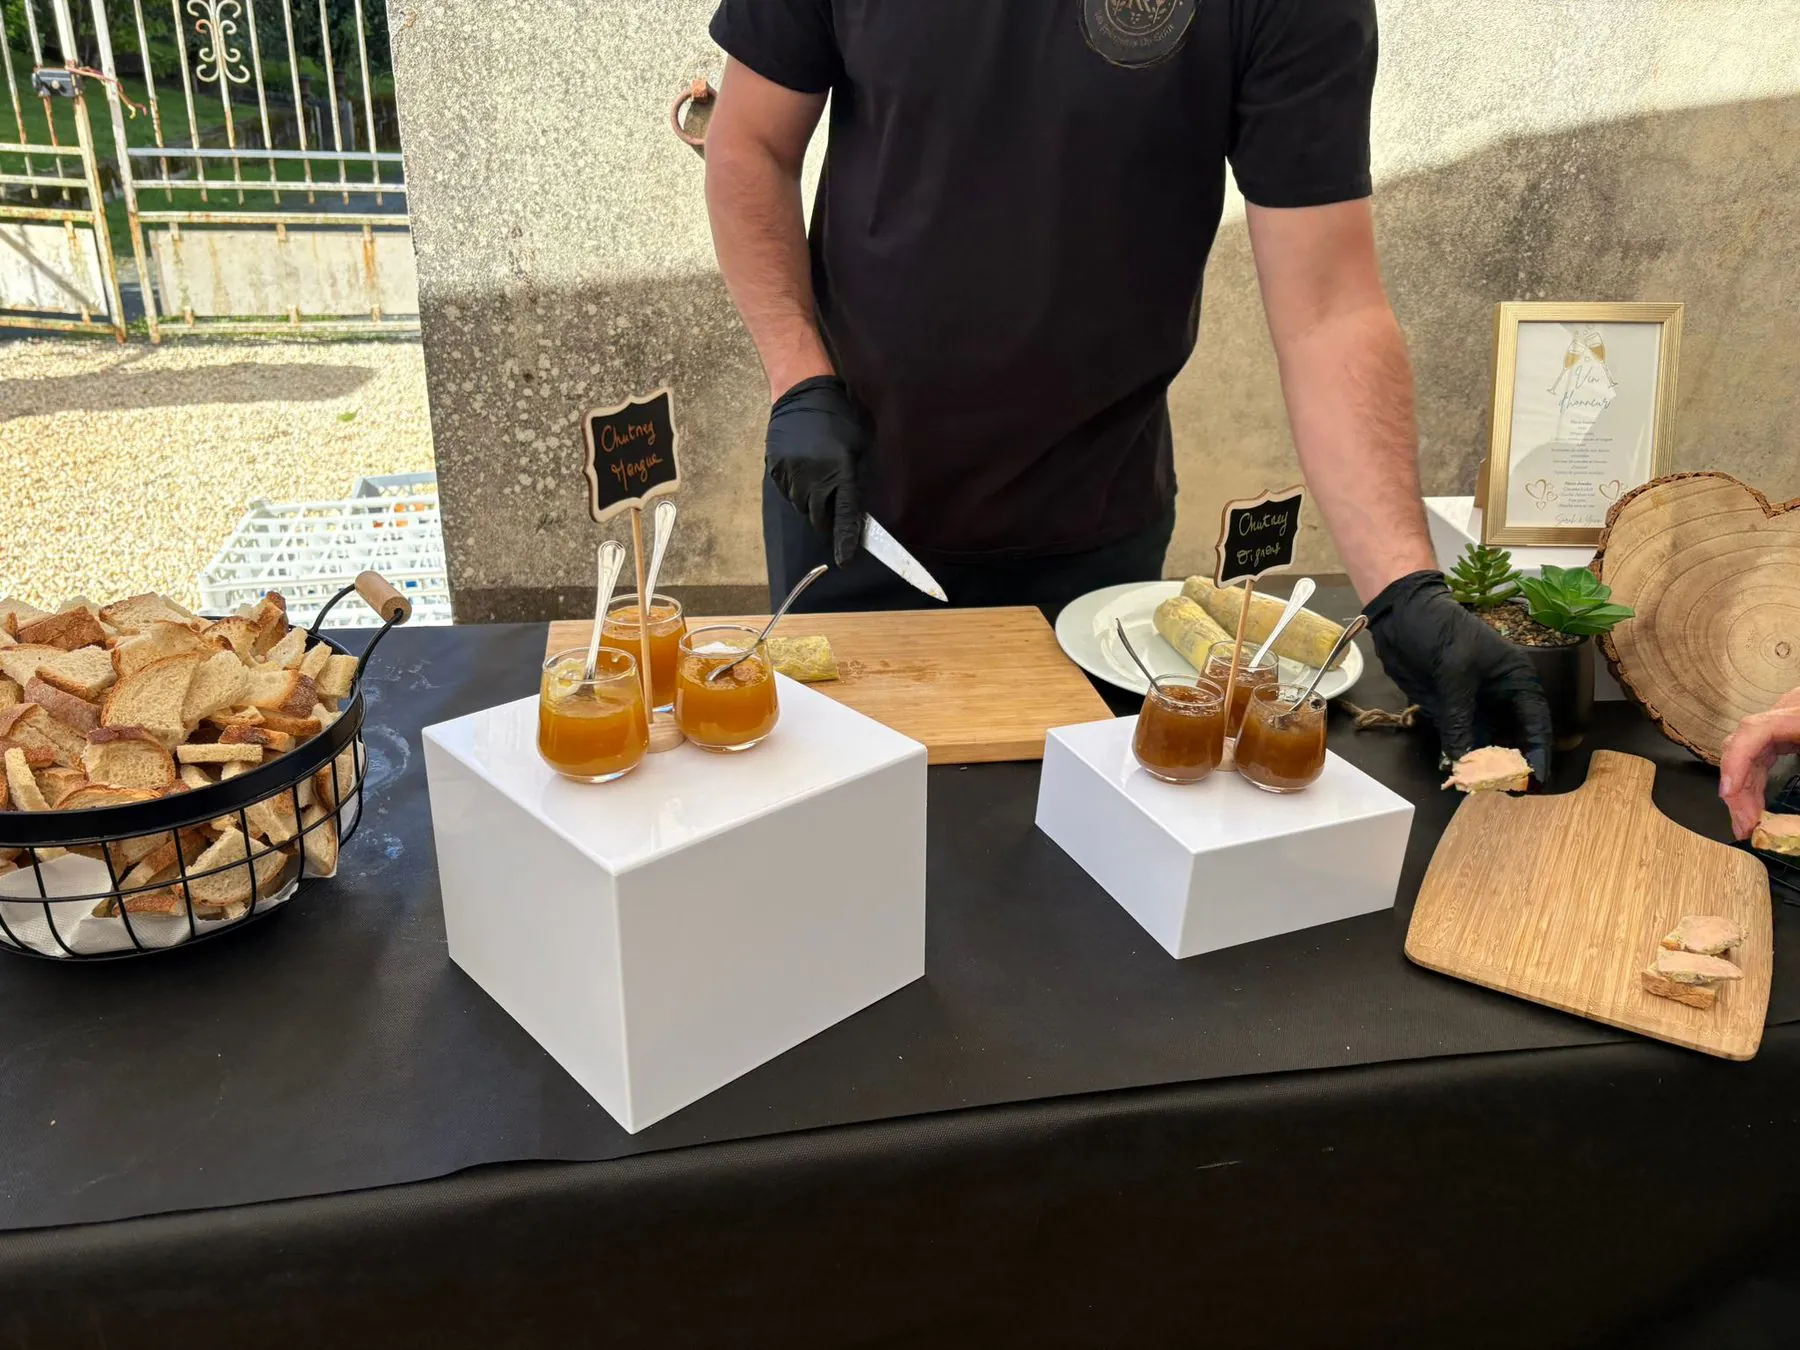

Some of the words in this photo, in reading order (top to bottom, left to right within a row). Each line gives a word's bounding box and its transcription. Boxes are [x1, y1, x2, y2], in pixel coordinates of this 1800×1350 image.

[1574, 364, 1600, 389] Vin
[601, 420, 656, 452] Chutney
[610, 453, 664, 491] Mangue
[1239, 510, 1289, 537] Chutney
